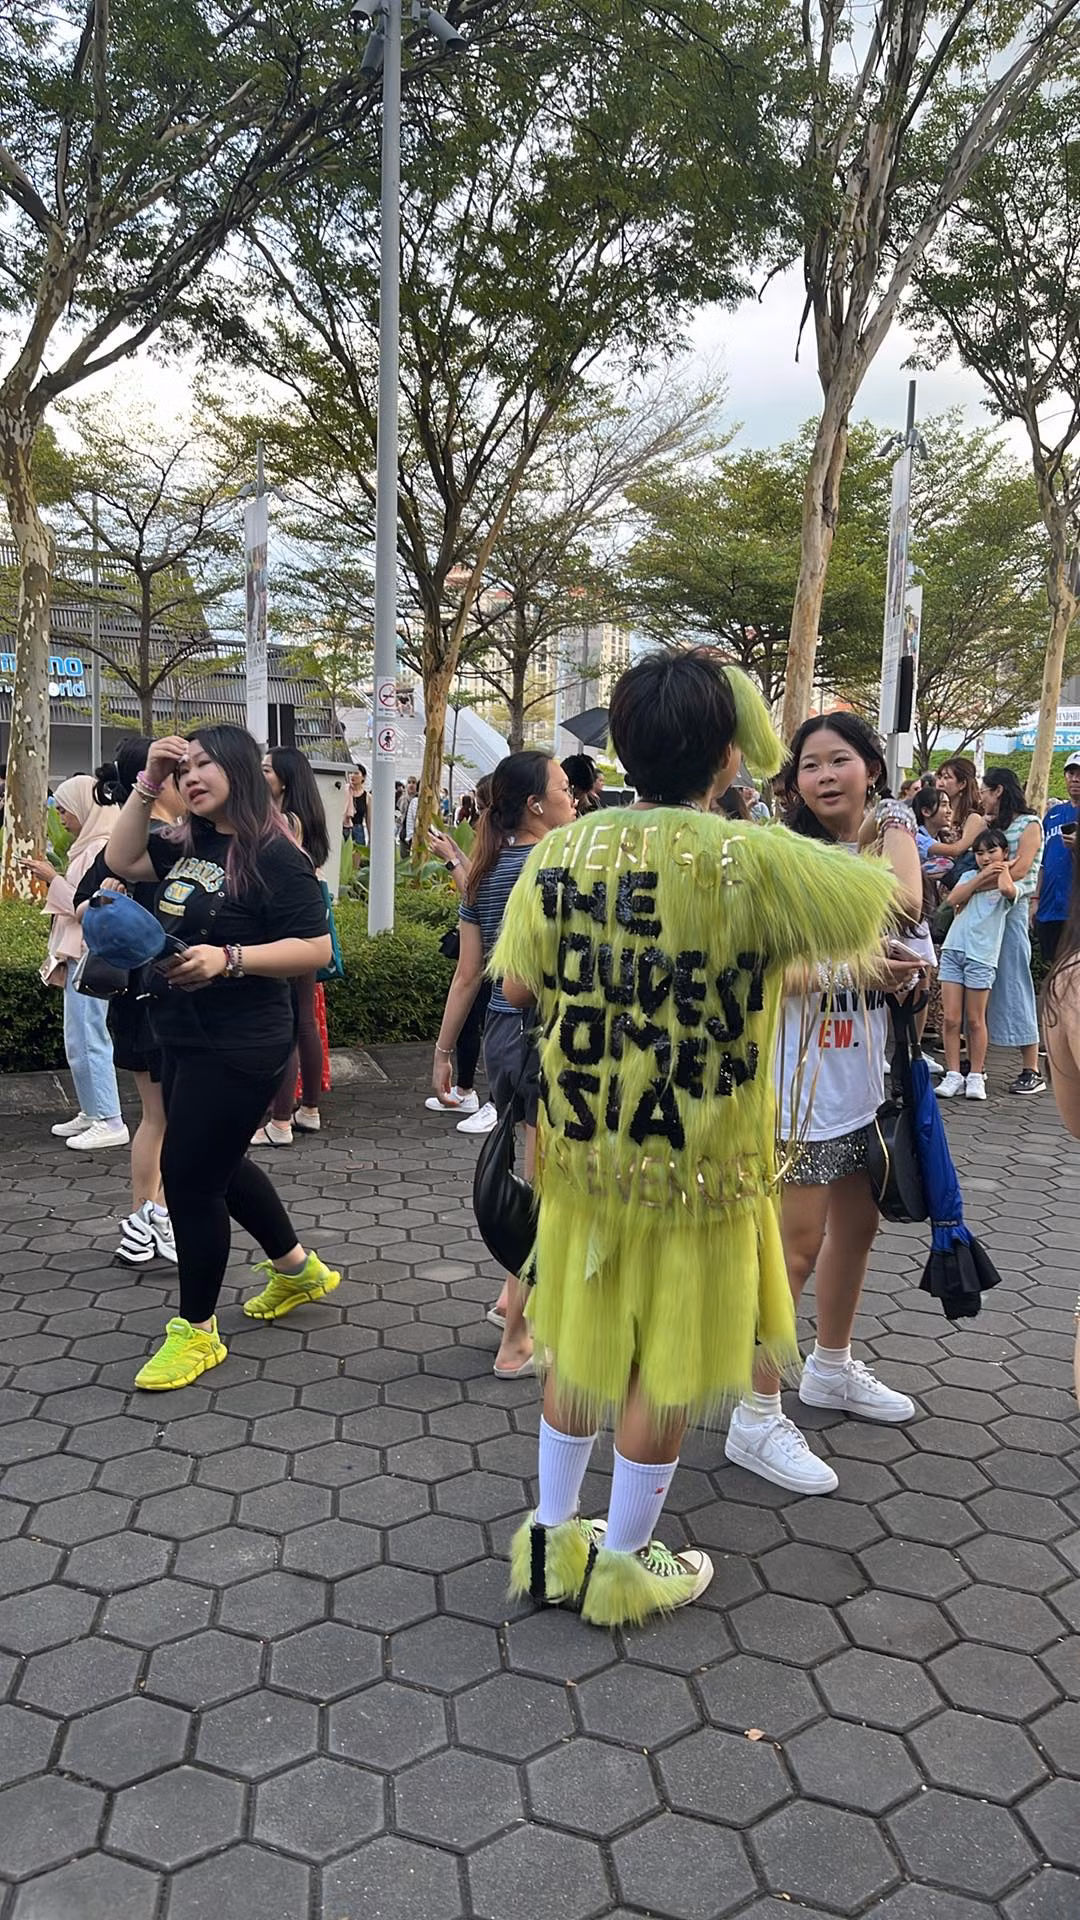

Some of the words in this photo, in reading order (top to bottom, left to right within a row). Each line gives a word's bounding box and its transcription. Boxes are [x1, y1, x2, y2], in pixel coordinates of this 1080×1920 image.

[48, 680, 87, 697] orld
[536, 867, 663, 940] THE
[543, 933, 769, 1042] OUDEST
[546, 1004, 759, 1098] OMEN
[818, 1019, 859, 1048] EW.
[540, 1065, 685, 1150] SIA
